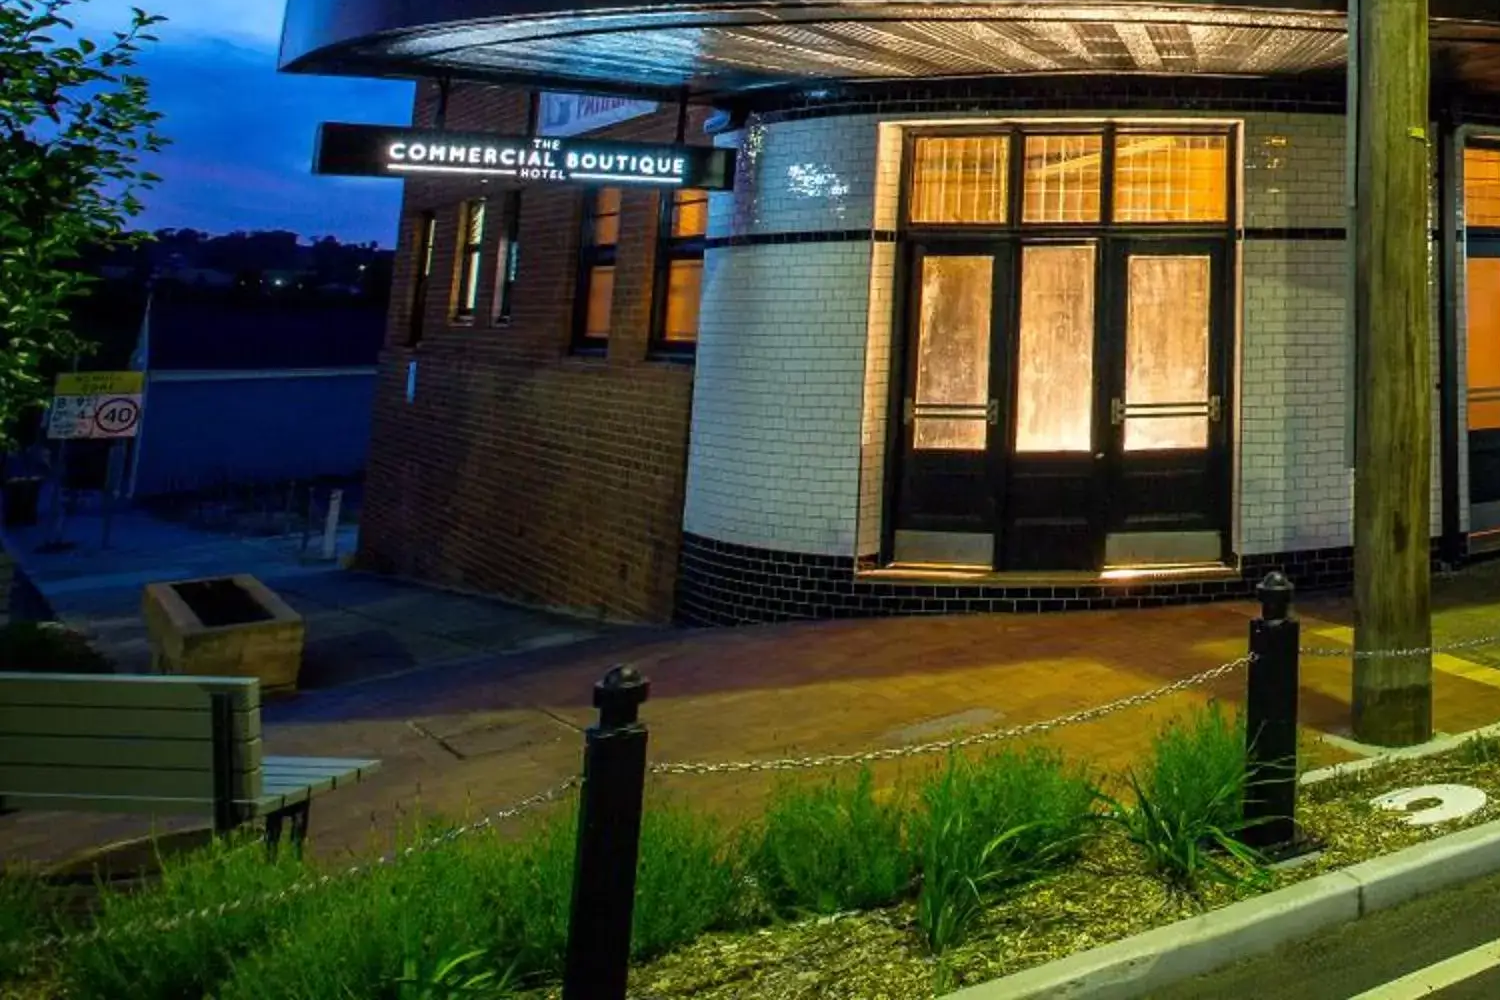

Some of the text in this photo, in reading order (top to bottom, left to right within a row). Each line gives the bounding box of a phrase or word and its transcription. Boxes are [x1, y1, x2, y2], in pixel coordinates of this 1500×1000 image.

[532, 139, 561, 151] THE
[388, 143, 686, 175] COMMERCIAL BOUTIQUE
[519, 169, 567, 181] HOTEL
[104, 408, 132, 423] 40
